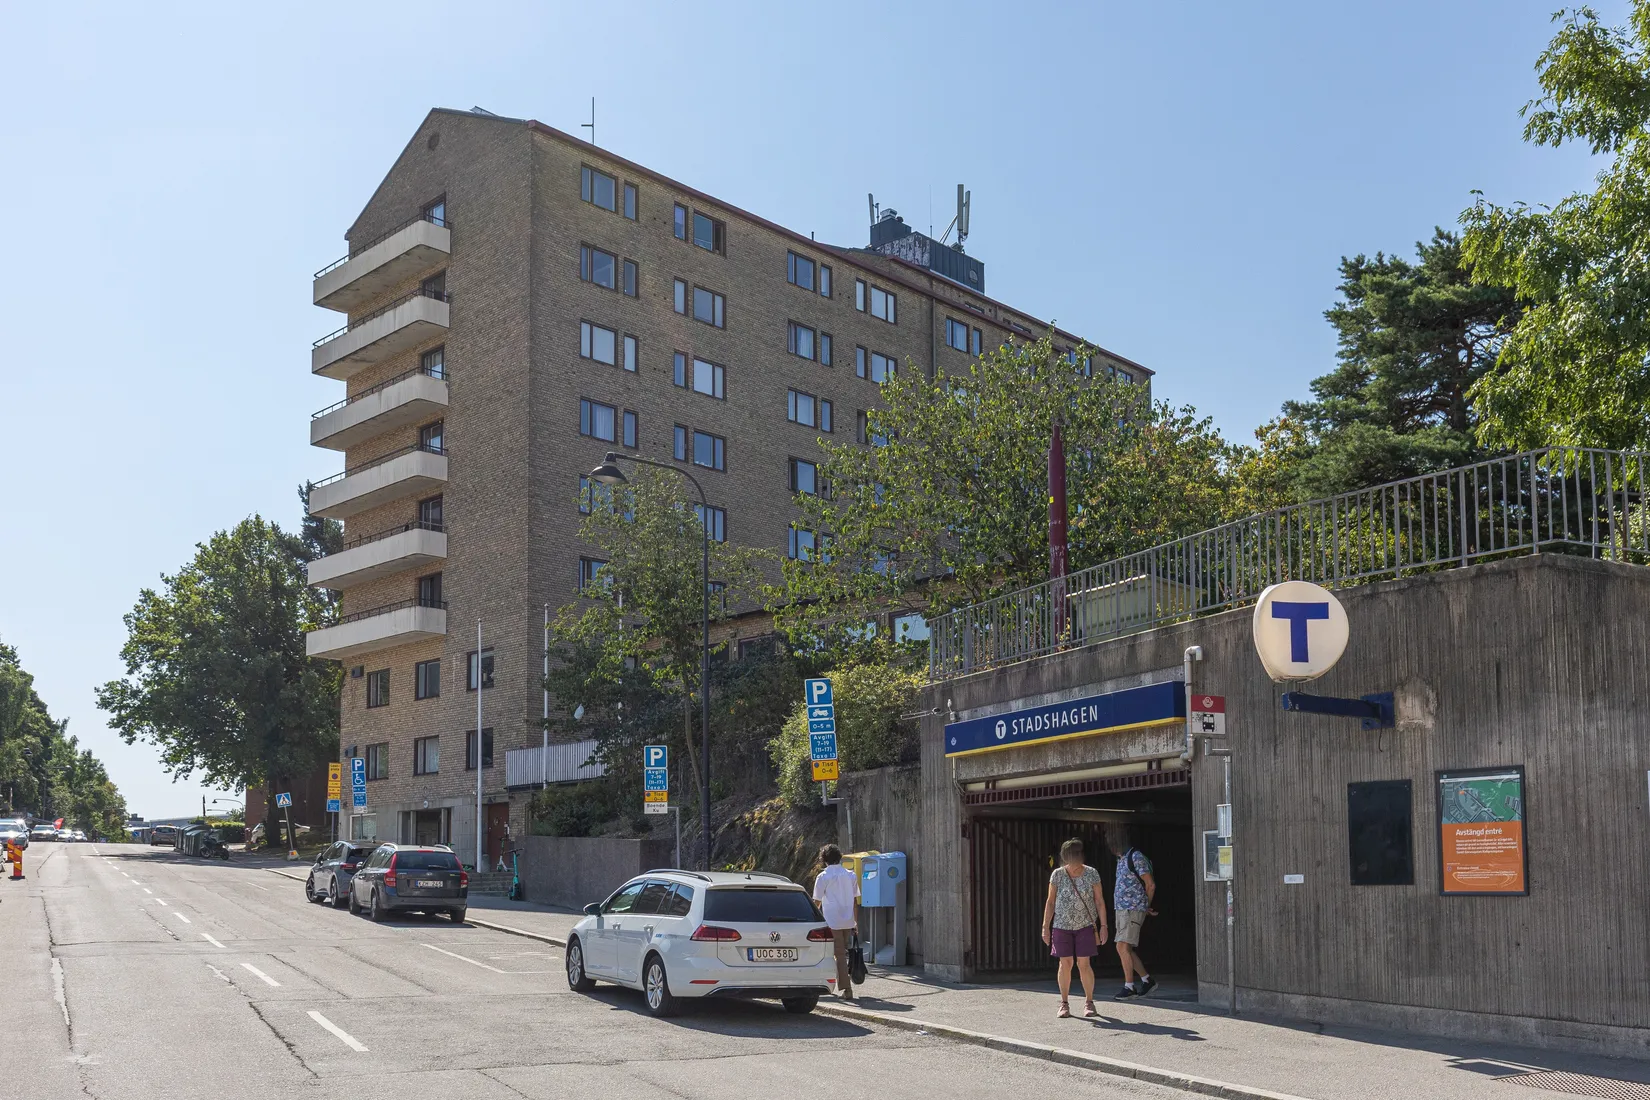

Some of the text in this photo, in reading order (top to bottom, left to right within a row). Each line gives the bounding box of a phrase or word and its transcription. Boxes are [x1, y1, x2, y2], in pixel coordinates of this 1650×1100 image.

[1271, 601, 1329, 663] T
[812, 681, 827, 703] P
[1012, 704, 1098, 735] STADSHAGEN
[354, 760, 362, 770] P
[650, 748, 663, 766] P
[1456, 828, 1484, 837] Avstängd
[756, 949, 794, 958] UOC 38D
